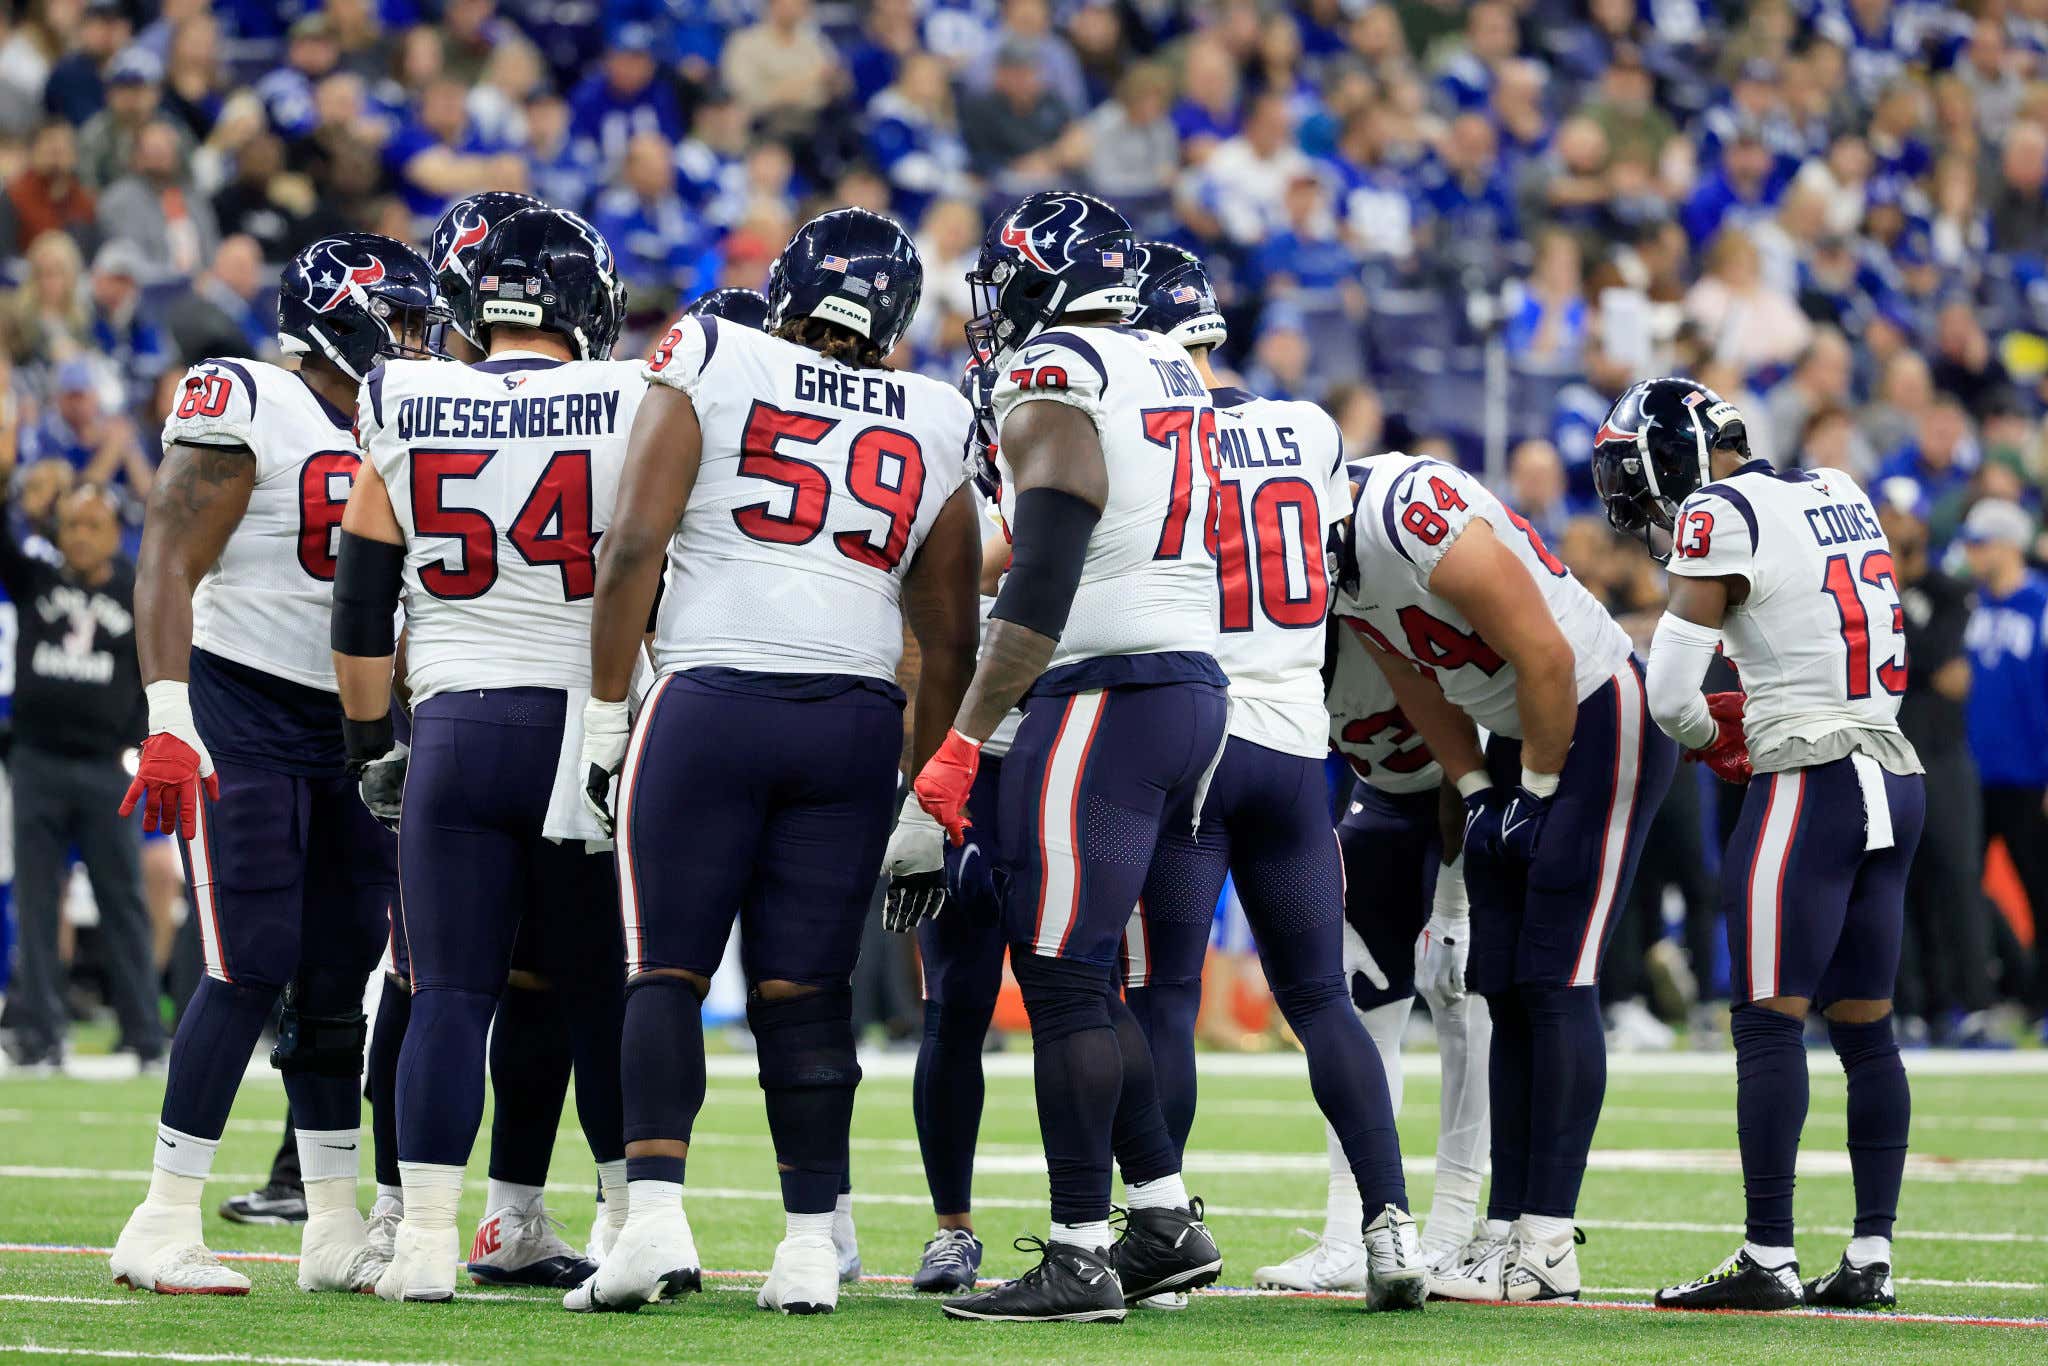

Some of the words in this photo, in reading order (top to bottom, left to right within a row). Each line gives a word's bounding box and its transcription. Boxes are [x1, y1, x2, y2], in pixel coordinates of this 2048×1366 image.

[485, 307, 536, 318] TEXANS
[824, 303, 868, 324] TEXANS
[1186, 321, 1226, 334] TEXA
[649, 328, 683, 372] 9
[176, 374, 233, 419] 60
[397, 390, 620, 441] QUESSENBERRY
[795, 362, 905, 420] GREEN
[1218, 426, 1302, 469] MILLS
[731, 398, 927, 574] 59
[1401, 475, 1469, 546] 84
[298, 449, 362, 581] 6
[408, 447, 605, 603] 54
[1675, 510, 1715, 559] 13
[1804, 502, 1883, 547] COOKS
[1216, 476, 1329, 634] 10
[1820, 549, 1909, 701] 13
[468, 1217, 503, 1265] IKE
